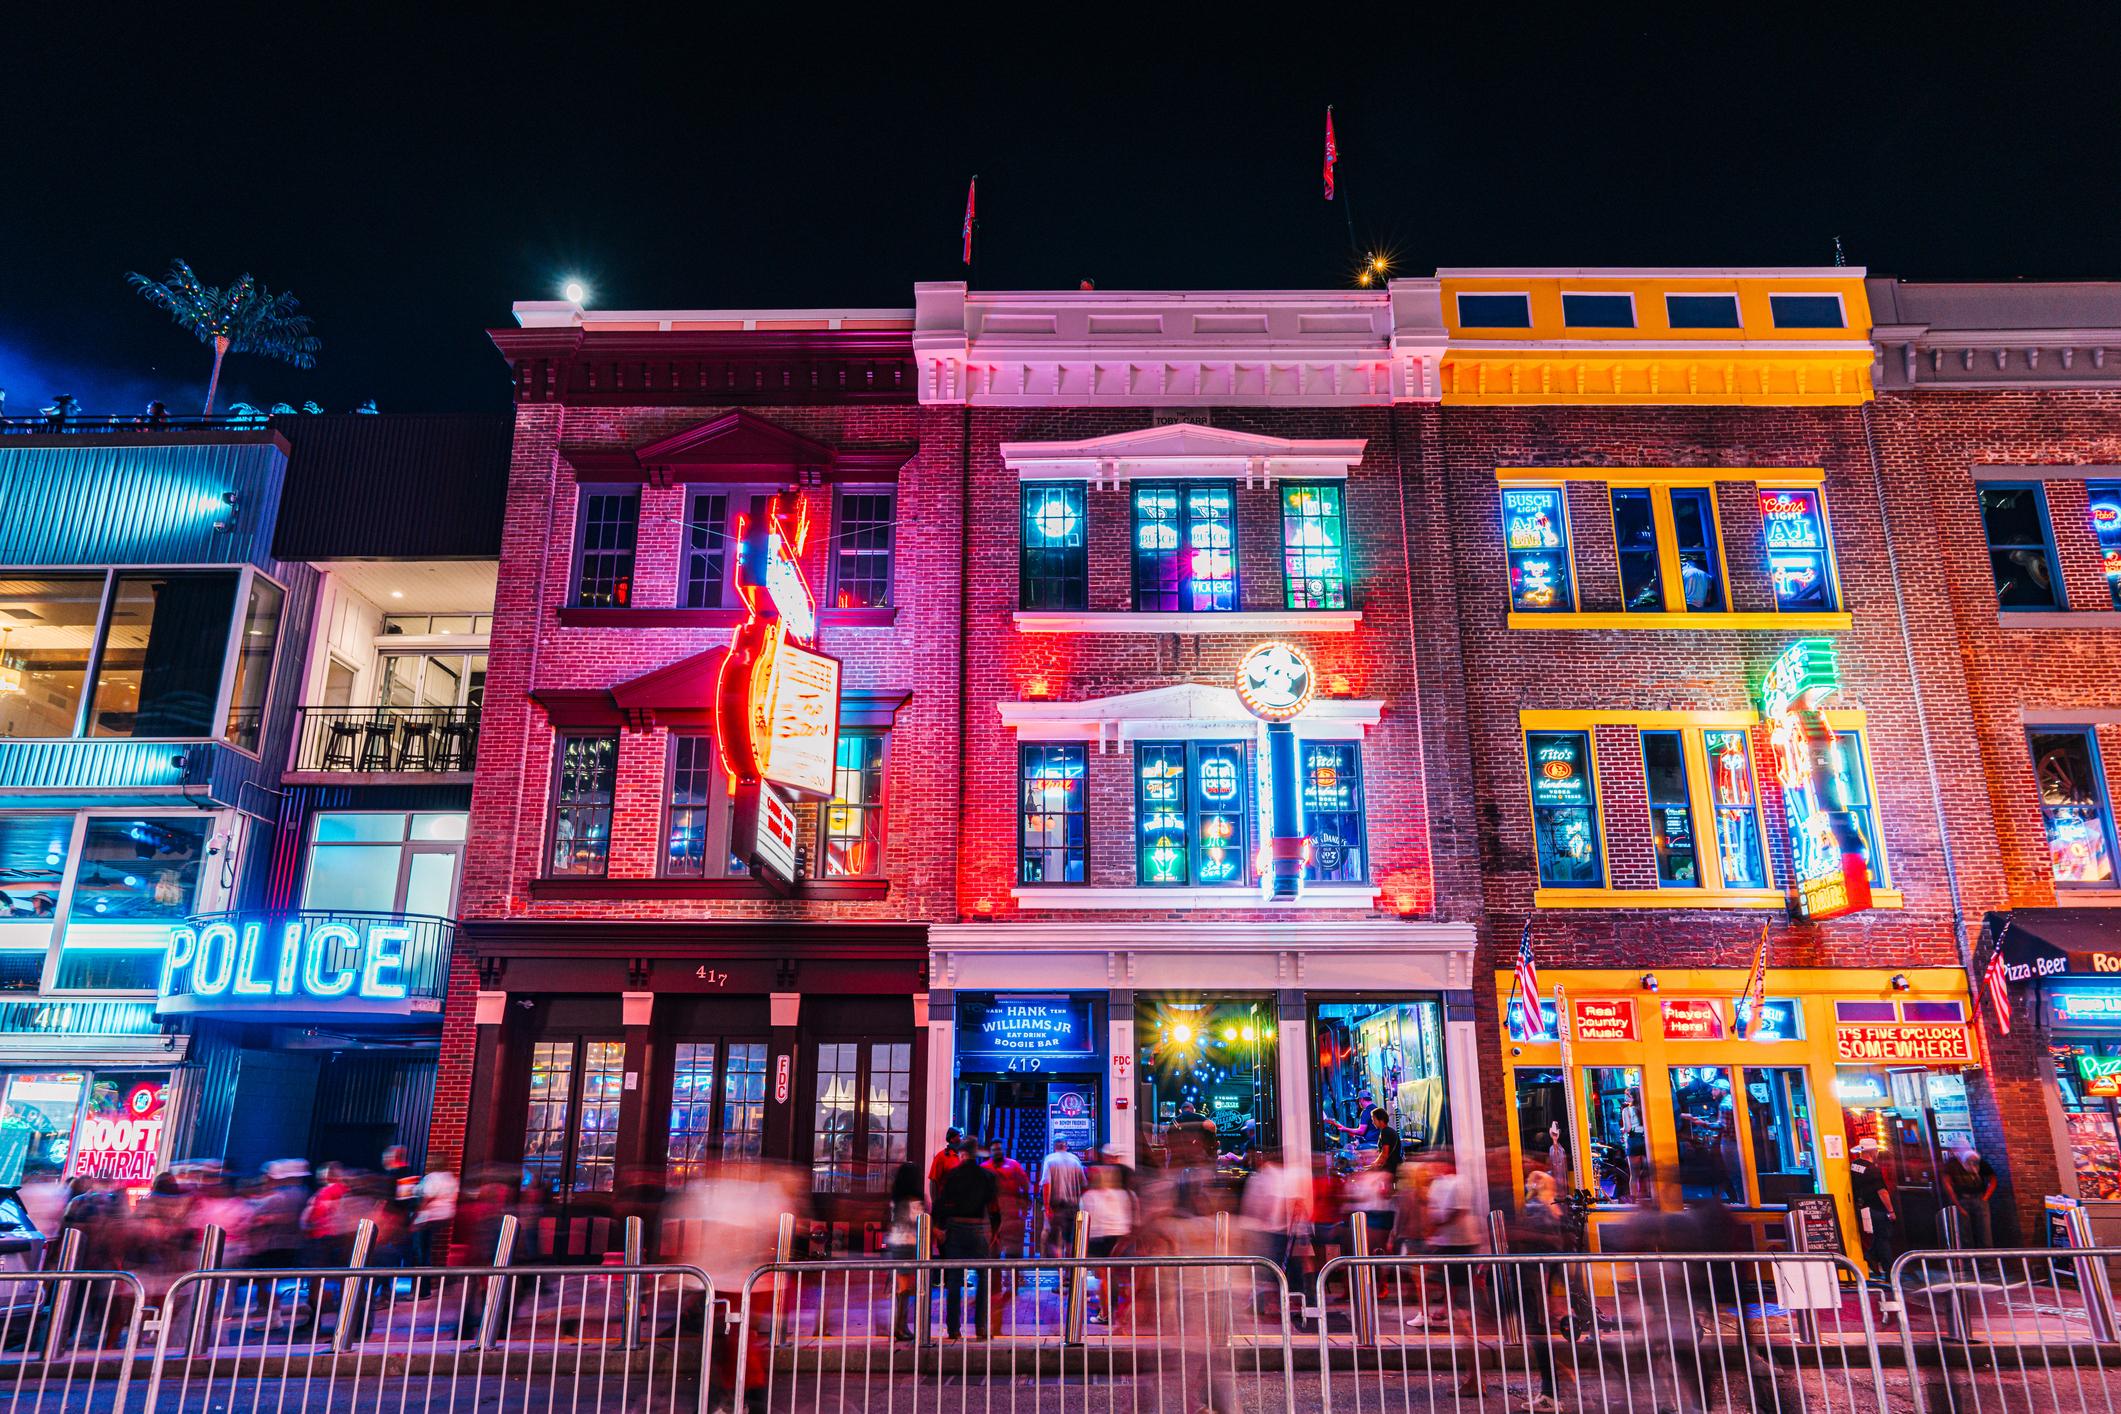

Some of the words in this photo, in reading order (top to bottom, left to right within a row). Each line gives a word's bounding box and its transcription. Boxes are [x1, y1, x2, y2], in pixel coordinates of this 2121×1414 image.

[1507, 495, 1552, 508] BUSCH
[1763, 498, 1806, 512] Coors
[1769, 512, 1802, 520] LIGHT
[2096, 510, 2116, 519] Pabst
[1540, 748, 1573, 760] Tito's
[160, 922, 412, 998] POLICE
[2093, 953, 2121, 972] Ro
[2036, 957, 2066, 976] Beer
[696, 965, 728, 987] 417
[1007, 1006, 1047, 1016] HANK
[1585, 1006, 1616, 1016] Real
[1665, 1008, 1711, 1020] Played
[982, 1019, 1052, 1032] WILLIAMS
[1053, 1021, 1072, 1033] JR
[1577, 1017, 1629, 1029] Country
[1582, 1028, 1624, 1038] Music
[1866, 1028, 1898, 1039] FIVE
[1900, 1028, 1962, 1039] O'CLOCK
[994, 1038, 1035, 1048] BOOGIE
[1037, 1038, 1059, 1048] BAR
[1839, 1040, 1967, 1058] SOMEWHERE
[1008, 1057, 1041, 1071] 419
[1113, 1056, 1131, 1066] FDC
[776, 1059, 787, 1099] FDC
